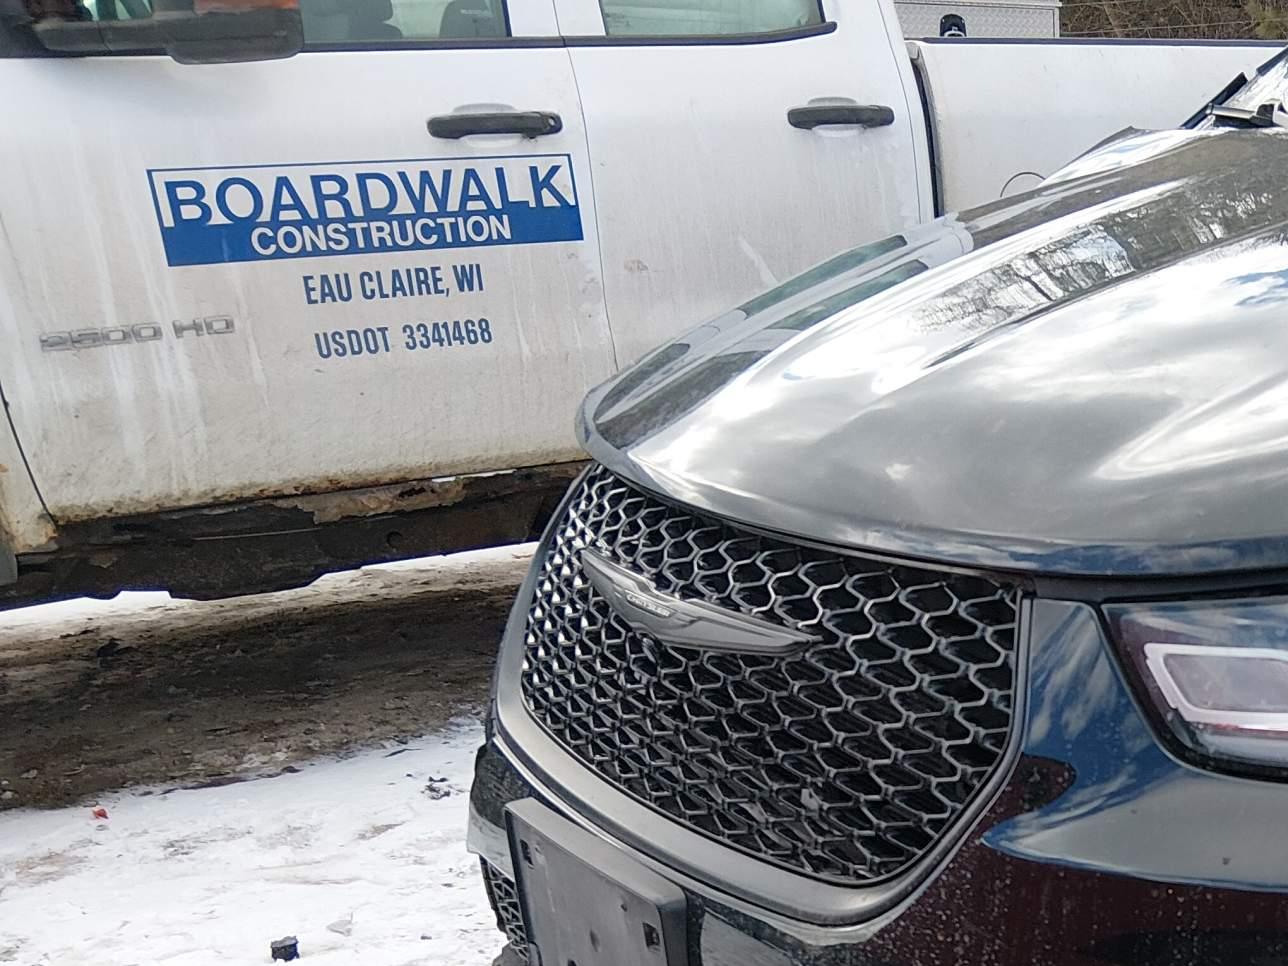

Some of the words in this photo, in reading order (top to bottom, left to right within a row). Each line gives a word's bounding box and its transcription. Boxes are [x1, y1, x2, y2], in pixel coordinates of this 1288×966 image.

[163, 164, 576, 228] BOARDWALK
[251, 214, 512, 256] CONSTRUCTION
[302, 273, 353, 305] EAU
[359, 266, 450, 300] CLAIRE,
[452, 263, 484, 293] WI
[39, 322, 163, 352] 2500
[173, 314, 236, 339] HD
[314, 326, 390, 359] USDOT
[402, 318, 493, 351] 3341468
